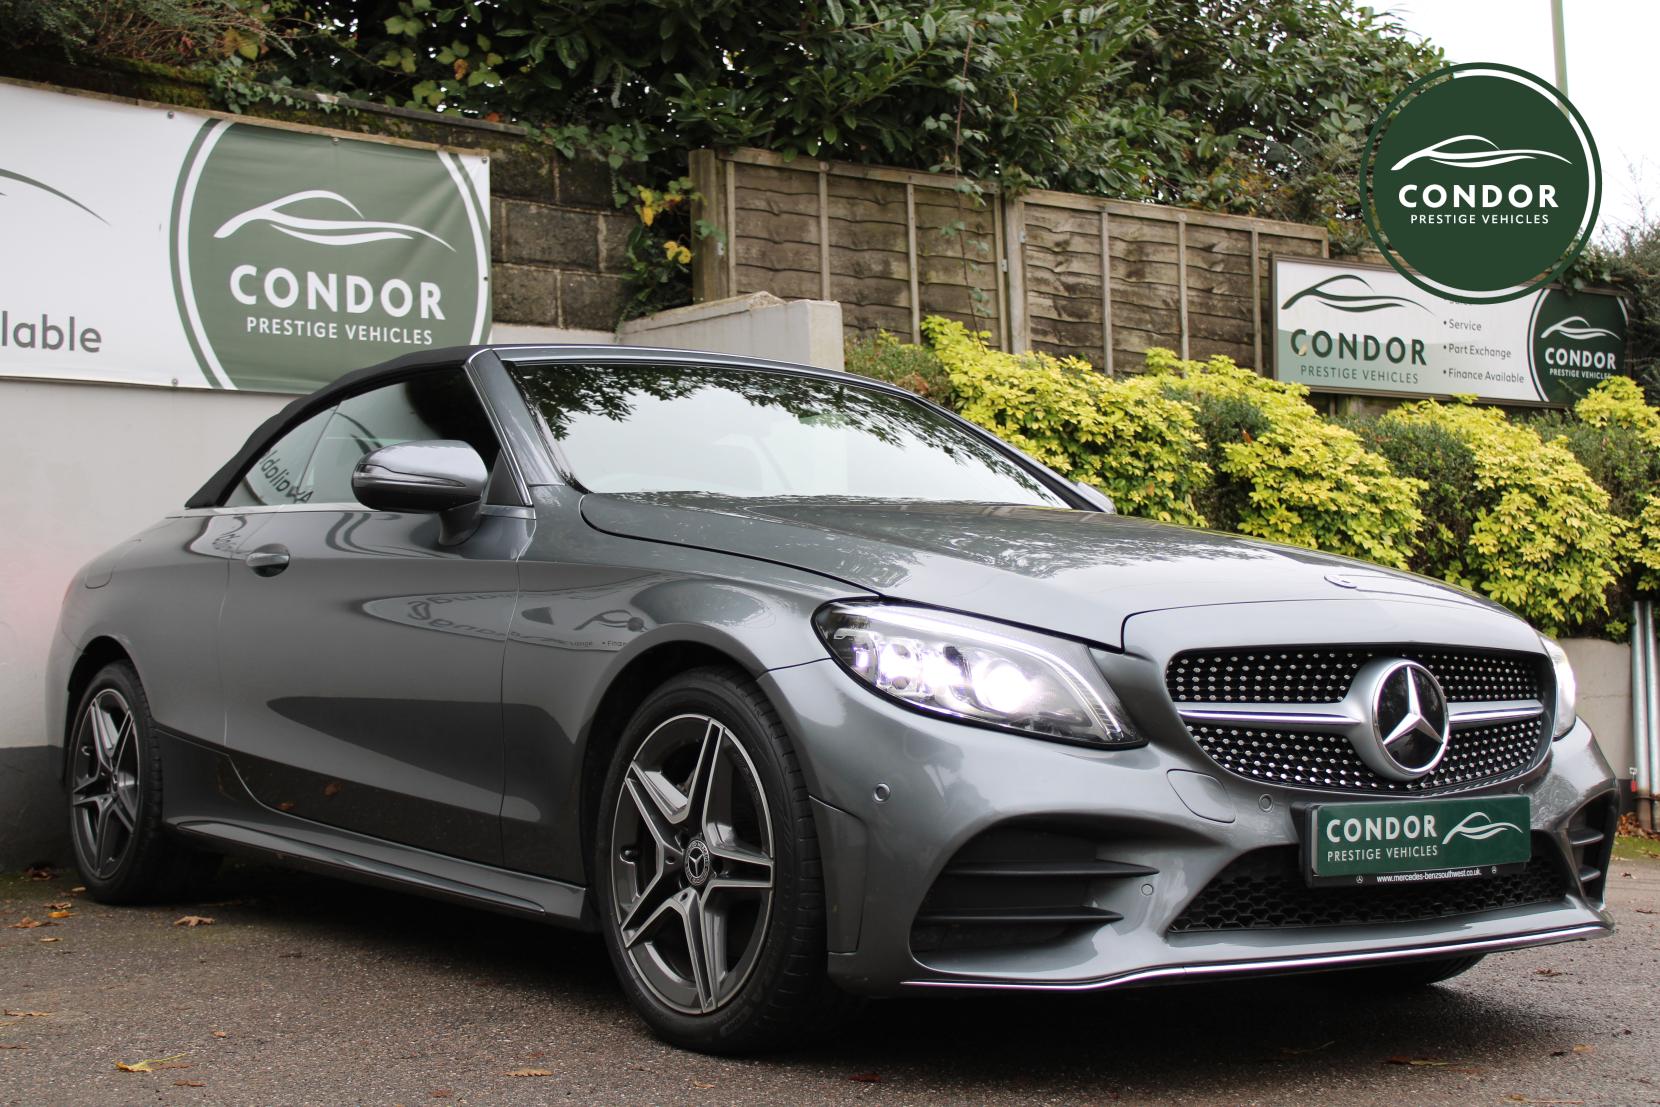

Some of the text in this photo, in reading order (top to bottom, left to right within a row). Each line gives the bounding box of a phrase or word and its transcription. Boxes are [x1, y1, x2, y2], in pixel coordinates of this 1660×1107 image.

[230, 264, 446, 321] CONDOR
[1, 311, 102, 353] lable
[247, 317, 433, 345] PRESTIGE VEHICLES
[1449, 319, 1482, 331] Service
[1290, 329, 1427, 366] CONDOR
[1449, 343, 1512, 360] Part Exchange
[1544, 347, 1616, 370] CONDOR
[1301, 364, 1419, 385] PRESTIGE VEHICLES
[1448, 368, 1525, 383] Finance Available
[1549, 368, 1580, 378] PRESTIGE
[1326, 815, 1438, 843] CONDOR
[1327, 845, 1438, 862] PRESTIGE VEHICLES
